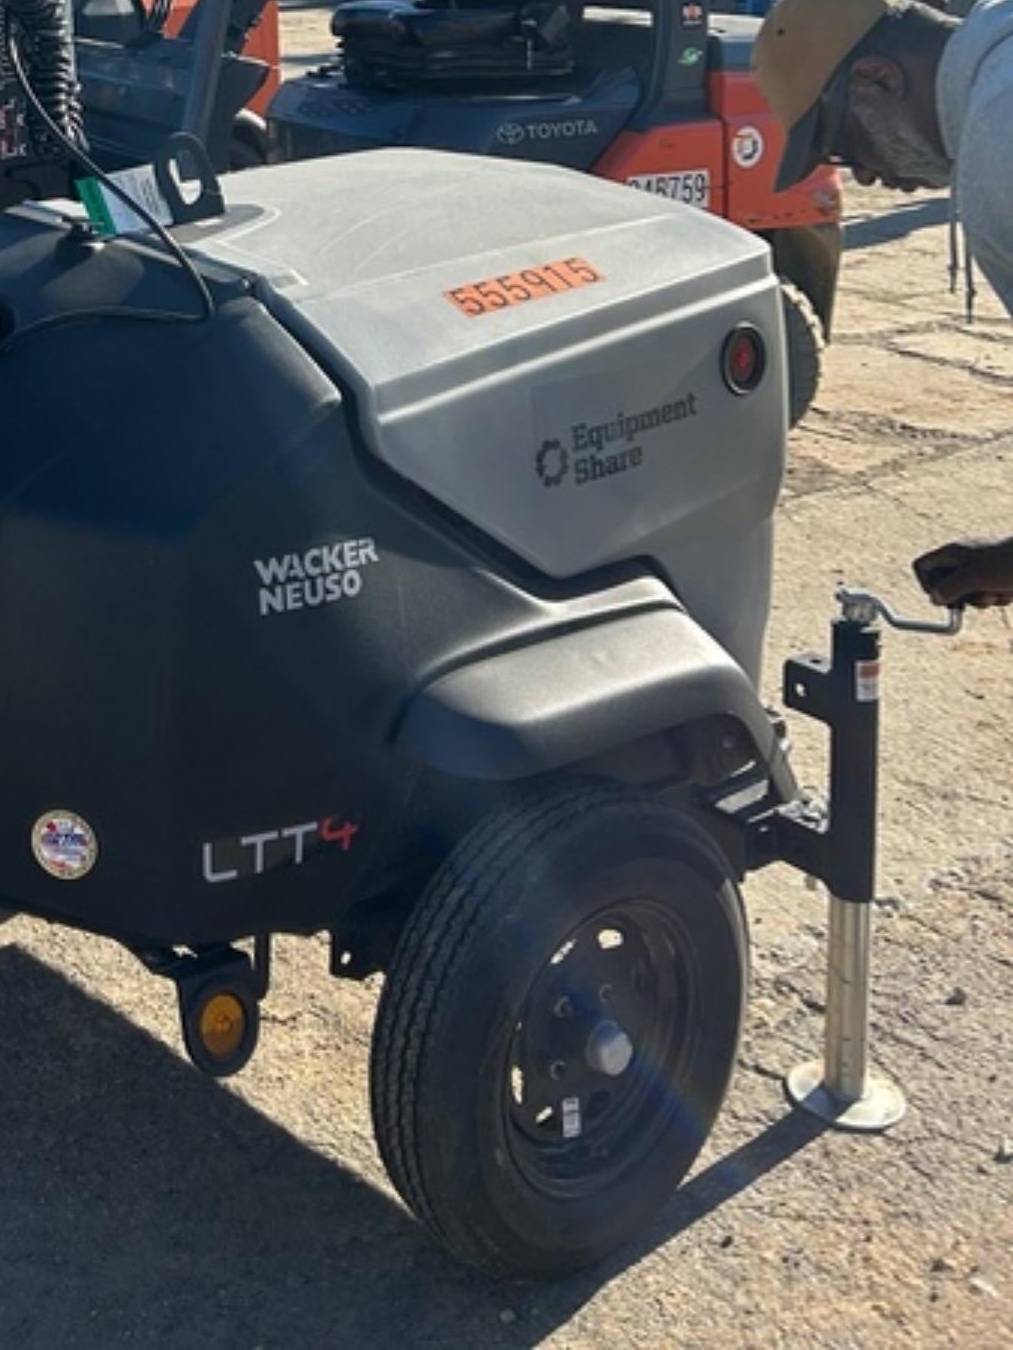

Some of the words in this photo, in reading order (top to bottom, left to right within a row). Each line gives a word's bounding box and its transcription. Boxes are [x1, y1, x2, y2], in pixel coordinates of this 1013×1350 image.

[526, 118, 597, 139] TOYOTA
[448, 257, 599, 315] 555915
[571, 391, 697, 452] Equipment
[574, 445, 643, 485] Share
[252, 536, 381, 586] WACKER
[201, 817, 359, 884] LTT4
